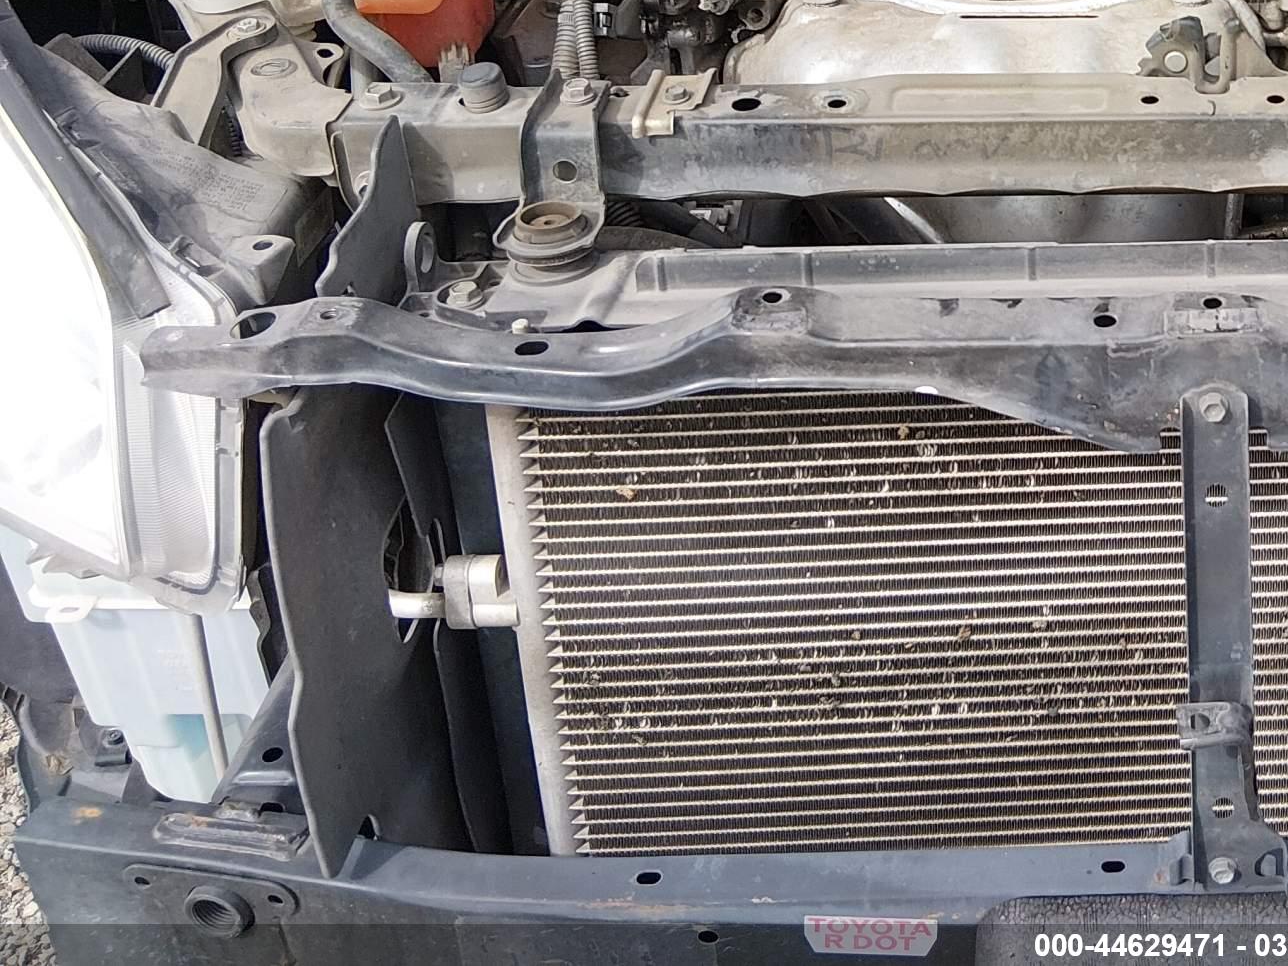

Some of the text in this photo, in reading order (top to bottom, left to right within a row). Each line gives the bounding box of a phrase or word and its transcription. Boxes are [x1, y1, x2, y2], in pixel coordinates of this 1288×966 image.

[807, 917, 932, 937] TOYOTA
[824, 934, 917, 951] R DOT
